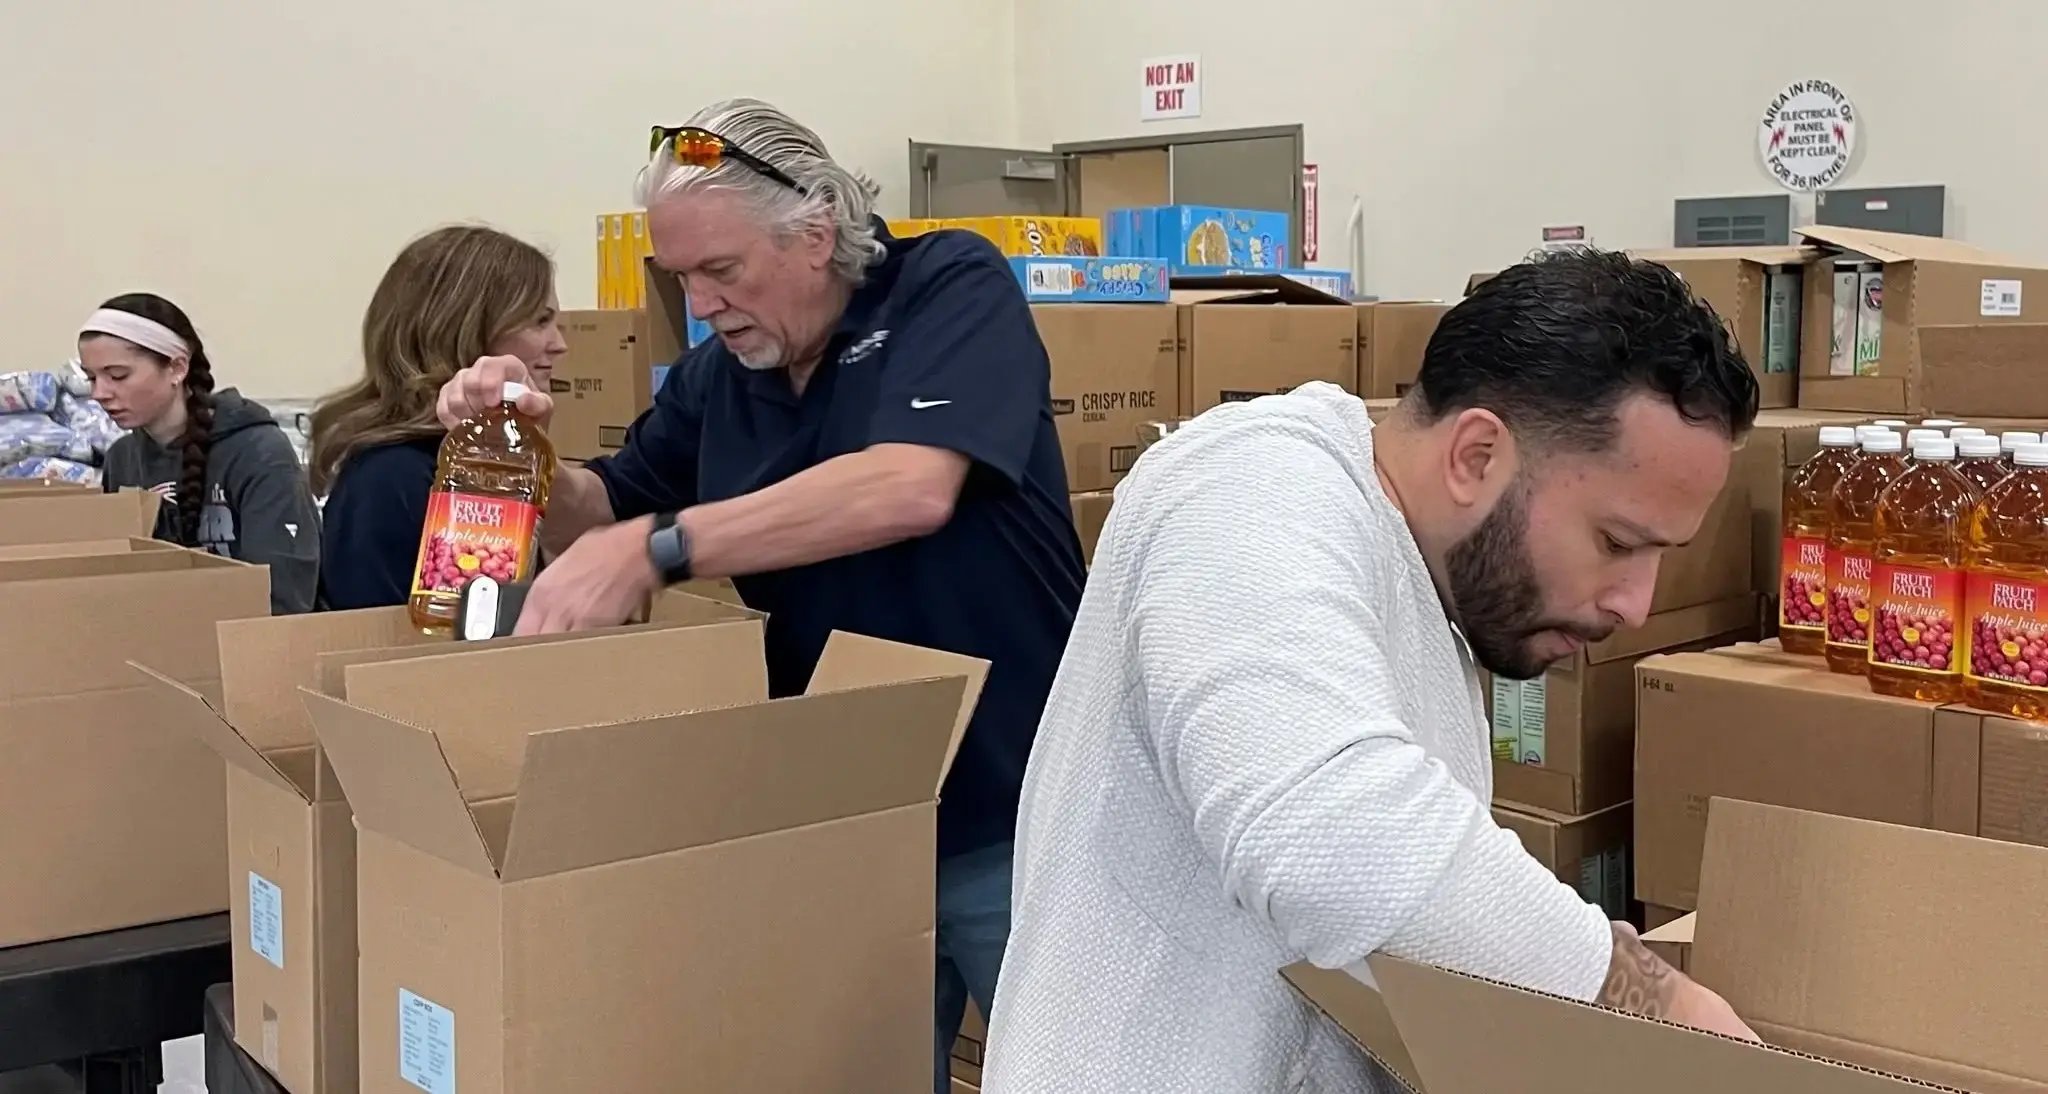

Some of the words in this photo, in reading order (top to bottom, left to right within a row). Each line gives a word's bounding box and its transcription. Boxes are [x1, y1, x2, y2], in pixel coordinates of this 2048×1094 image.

[1146, 64, 1173, 87] NOT
[1176, 61, 1194, 84] AN
[1156, 88, 1184, 111] EXIT
[1763, 93, 1790, 129] AREA
[1789, 82, 1804, 97] IN
[1806, 80, 1845, 105] FRONT
[1840, 104, 1854, 124] OF
[1780, 108, 1838, 121] ELECTRICAL
[1793, 122, 1825, 133] PANEL
[1788, 134, 1816, 145] MUST
[1818, 133, 1830, 144] BE
[1780, 147, 1805, 158] KEPT
[1807, 145, 1837, 157] CLEAR
[1768, 156, 1791, 182] FOR
[1790, 174, 1807, 188] 36
[1808, 152, 1847, 188] INCHES
[1860, 340, 1880, 360] MI
[1082, 392, 1126, 411] CRISPY
[1129, 390, 1156, 408] RICE
[455, 500, 504, 516] FRUIT
[455, 511, 502, 528] PATCH
[435, 527, 476, 544] Apple
[478, 530, 514, 546] Juice
[1801, 544, 1825, 556] FRU
[1801, 554, 1825, 565] PATC
[1844, 557, 1871, 570] FRUI
[1790, 568, 1820, 583] Apple
[1844, 567, 1871, 580] PATC
[1893, 572, 1933, 588] FRUIT
[1834, 582, 1864, 597] Apple
[1892, 582, 1932, 599] PATCH
[1994, 583, 2035, 600] FRUIT
[1881, 599, 1913, 616] Apple
[1913, 602, 1947, 617] Juice
[1993, 594, 2034, 612] PATCH
[1980, 611, 2015, 628] Apple
[2015, 616, 2048, 632] Juice
